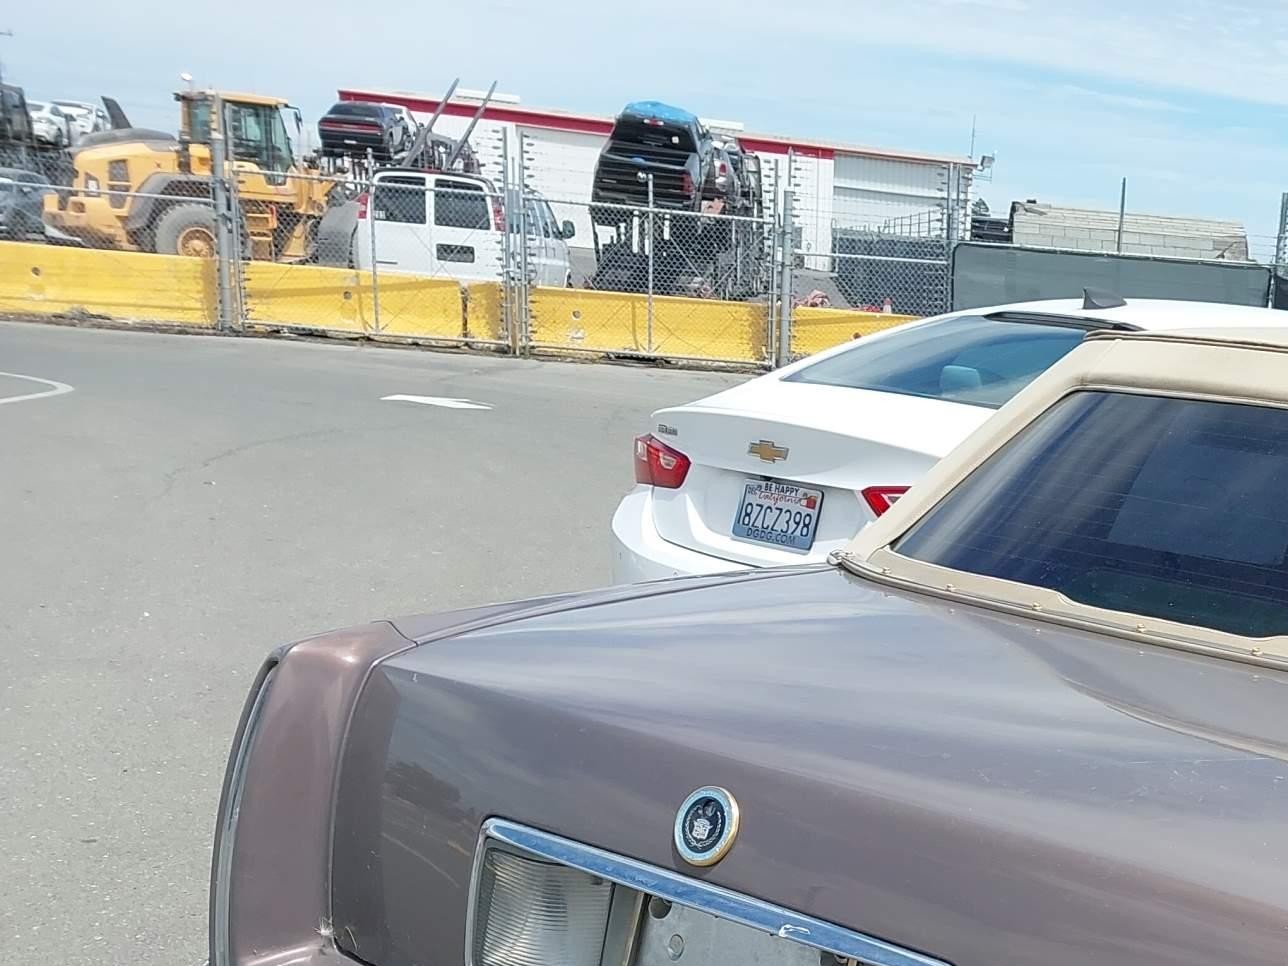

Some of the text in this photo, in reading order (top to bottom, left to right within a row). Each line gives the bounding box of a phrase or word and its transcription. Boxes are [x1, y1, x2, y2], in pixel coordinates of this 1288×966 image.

[764, 483, 799, 496] BE HAPPY
[742, 502, 812, 537] 8ZCZ398
[746, 528, 796, 544] DGDG.COM
